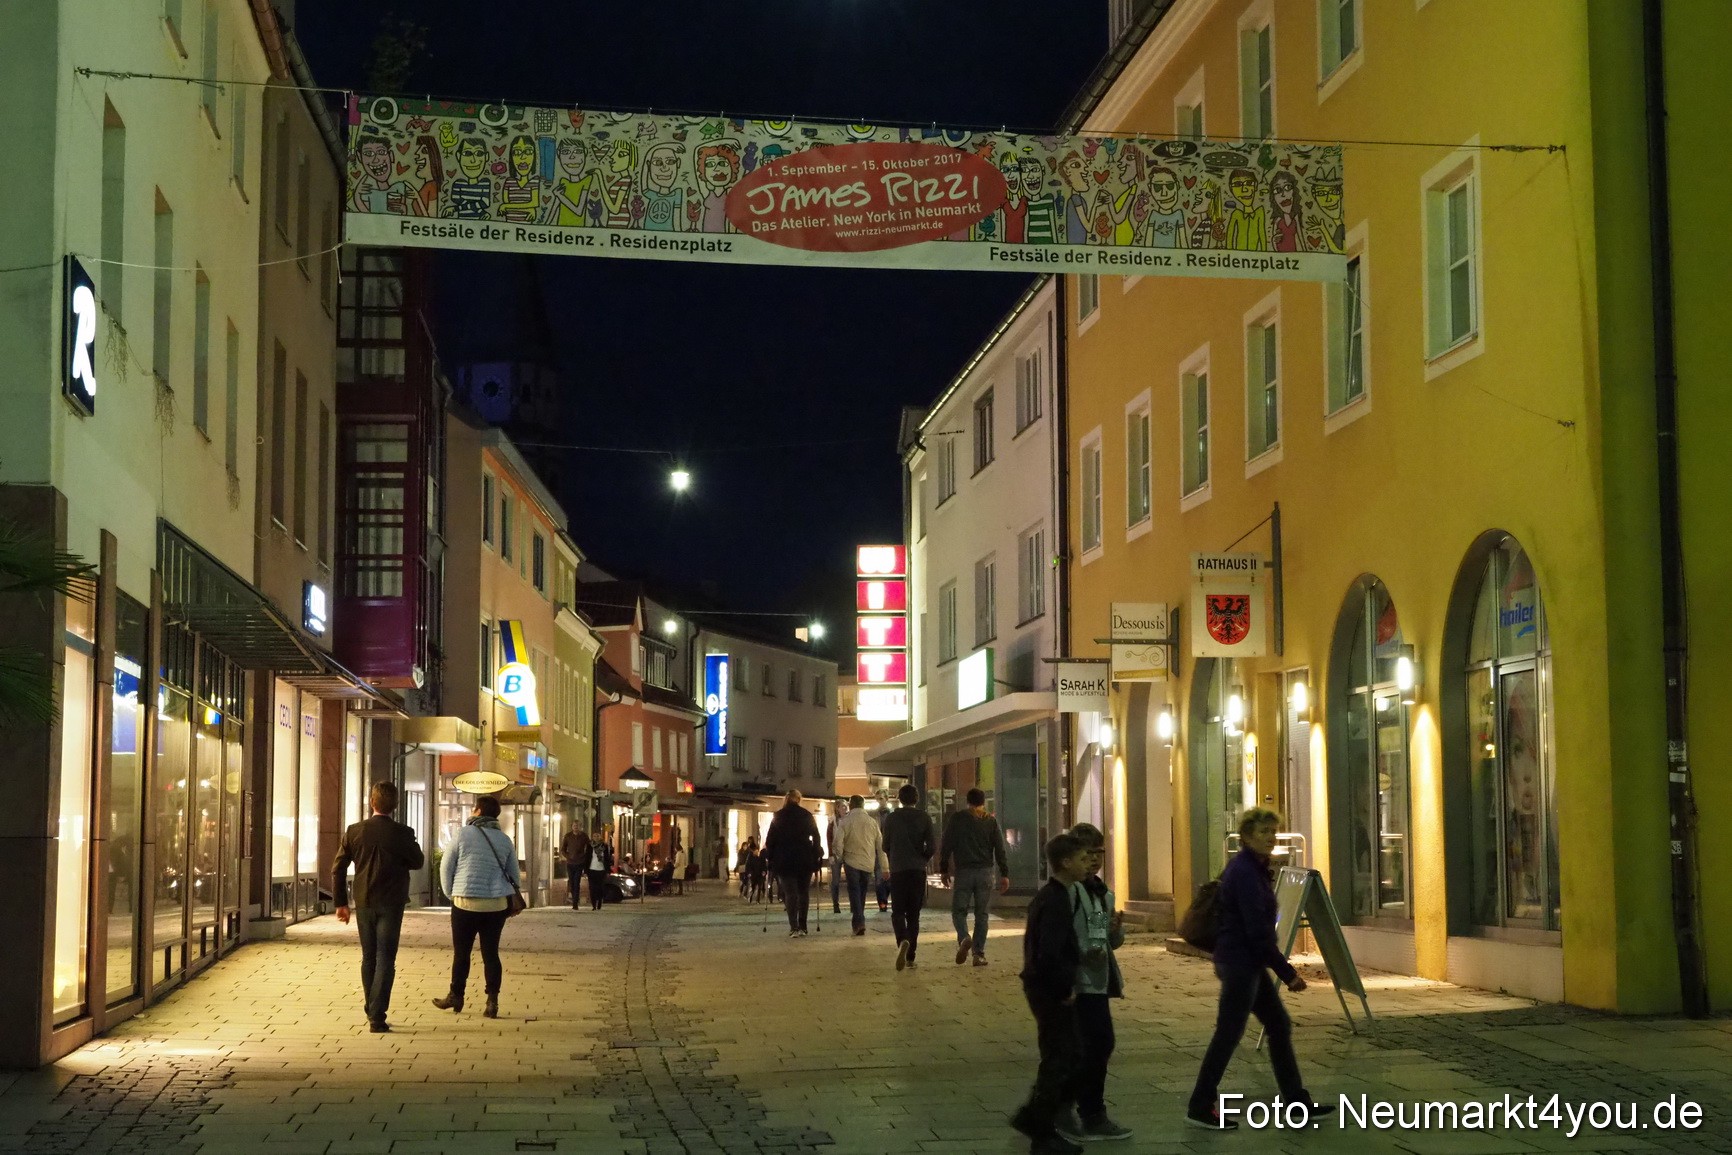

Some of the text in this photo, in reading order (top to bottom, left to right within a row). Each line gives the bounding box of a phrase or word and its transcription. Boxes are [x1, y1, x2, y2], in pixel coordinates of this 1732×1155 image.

[768, 167, 779, 177] 1.
[782, 161, 847, 177] September
[862, 159, 880, 171] 15.
[882, 156, 929, 170] Oktober
[933, 153, 962, 166] 2017
[752, 202, 982, 234] Das Atelier. New York in Neumarkt
[835, 219, 943, 239] www.rizzi-neumarkt.de
[400, 220, 475, 240] Festsäle
[479, 225, 510, 241] der
[515, 227, 595, 247] Residenz
[610, 233, 732, 254] Residenzplatz
[989, 246, 1060, 264] Festsäle
[1064, 249, 1093, 265] der
[1097, 251, 1172, 267] Residenz
[1186, 253, 1300, 272] Residenzplatz
[1197, 558, 1248, 570] RATHAUS
[1060, 678, 1105, 691] SARAH K
